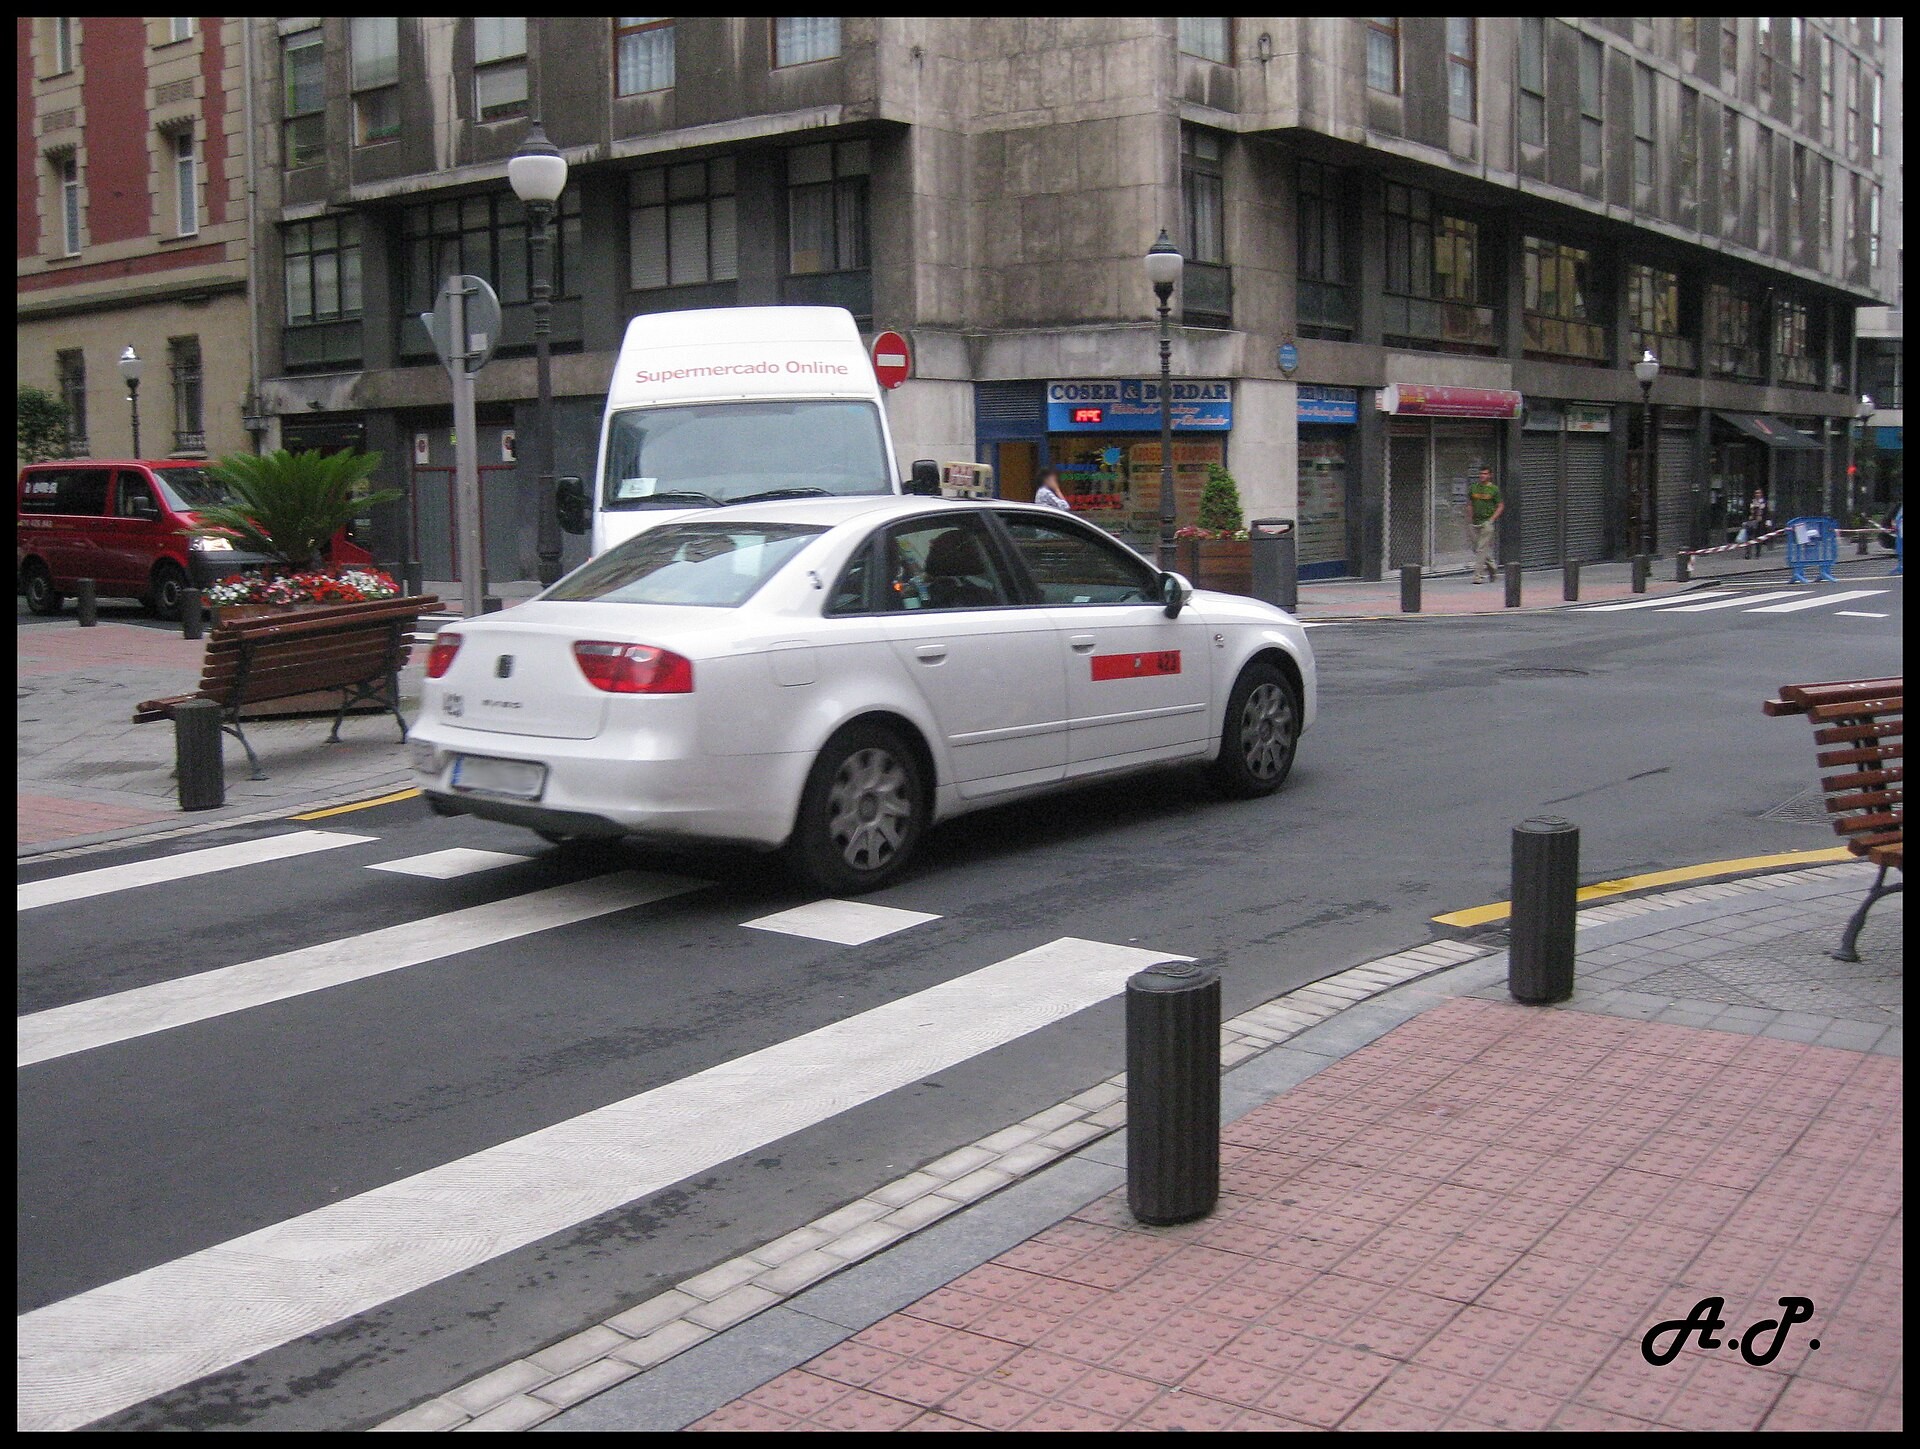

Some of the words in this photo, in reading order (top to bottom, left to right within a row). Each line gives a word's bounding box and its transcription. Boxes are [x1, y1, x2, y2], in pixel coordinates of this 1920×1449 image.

[635, 361, 780, 383] Supermercado
[785, 360, 849, 375] Online
[1050, 384, 1119, 400] COSER
[1123, 384, 1140, 399] &
